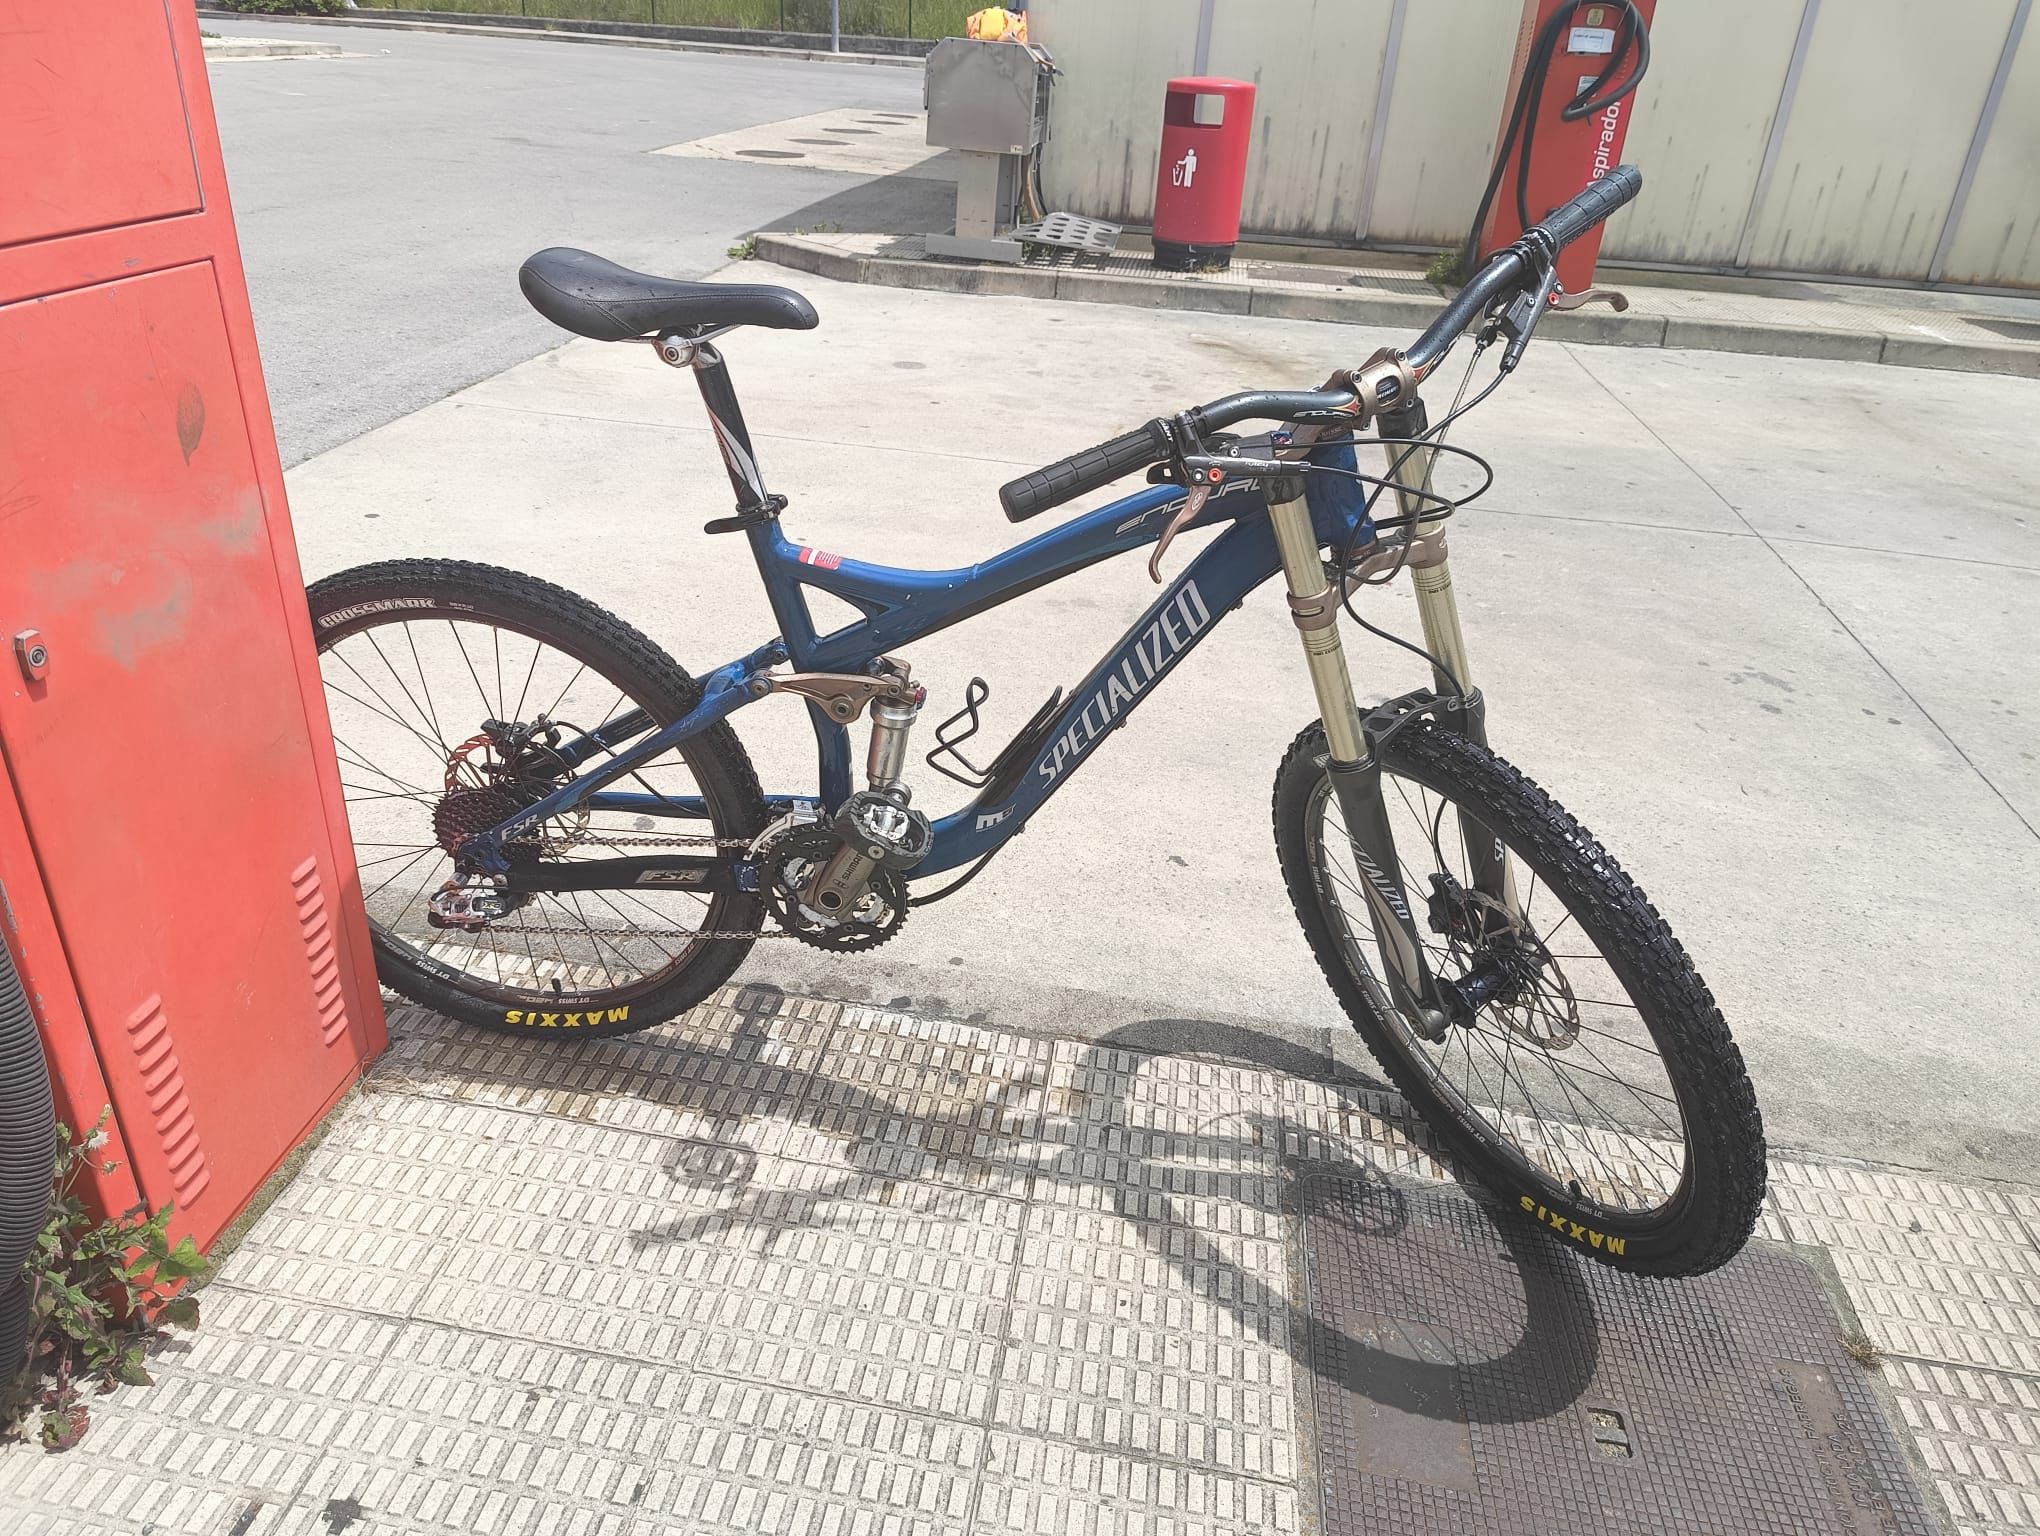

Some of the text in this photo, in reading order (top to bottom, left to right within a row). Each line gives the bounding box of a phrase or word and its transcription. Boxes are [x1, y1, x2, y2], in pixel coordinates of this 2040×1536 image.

[1587, 101, 1622, 187] spirado
[1115, 477, 1261, 535] ENDUR
[318, 597, 438, 629] CROSSMARK
[1038, 578, 1212, 790] SPECIALIZED
[501, 813, 539, 842] FSR
[841, 852, 864, 881] SHIMAN
[415, 960, 438, 974] SWISS
[436, 970, 451, 980] DT
[504, 1005, 630, 1028] MAXXIS
[1575, 1202, 1593, 1215] SWISS
[1520, 1196, 1626, 1256] MAXXIS
[1779, 1368, 1820, 1440] FABREGAS
